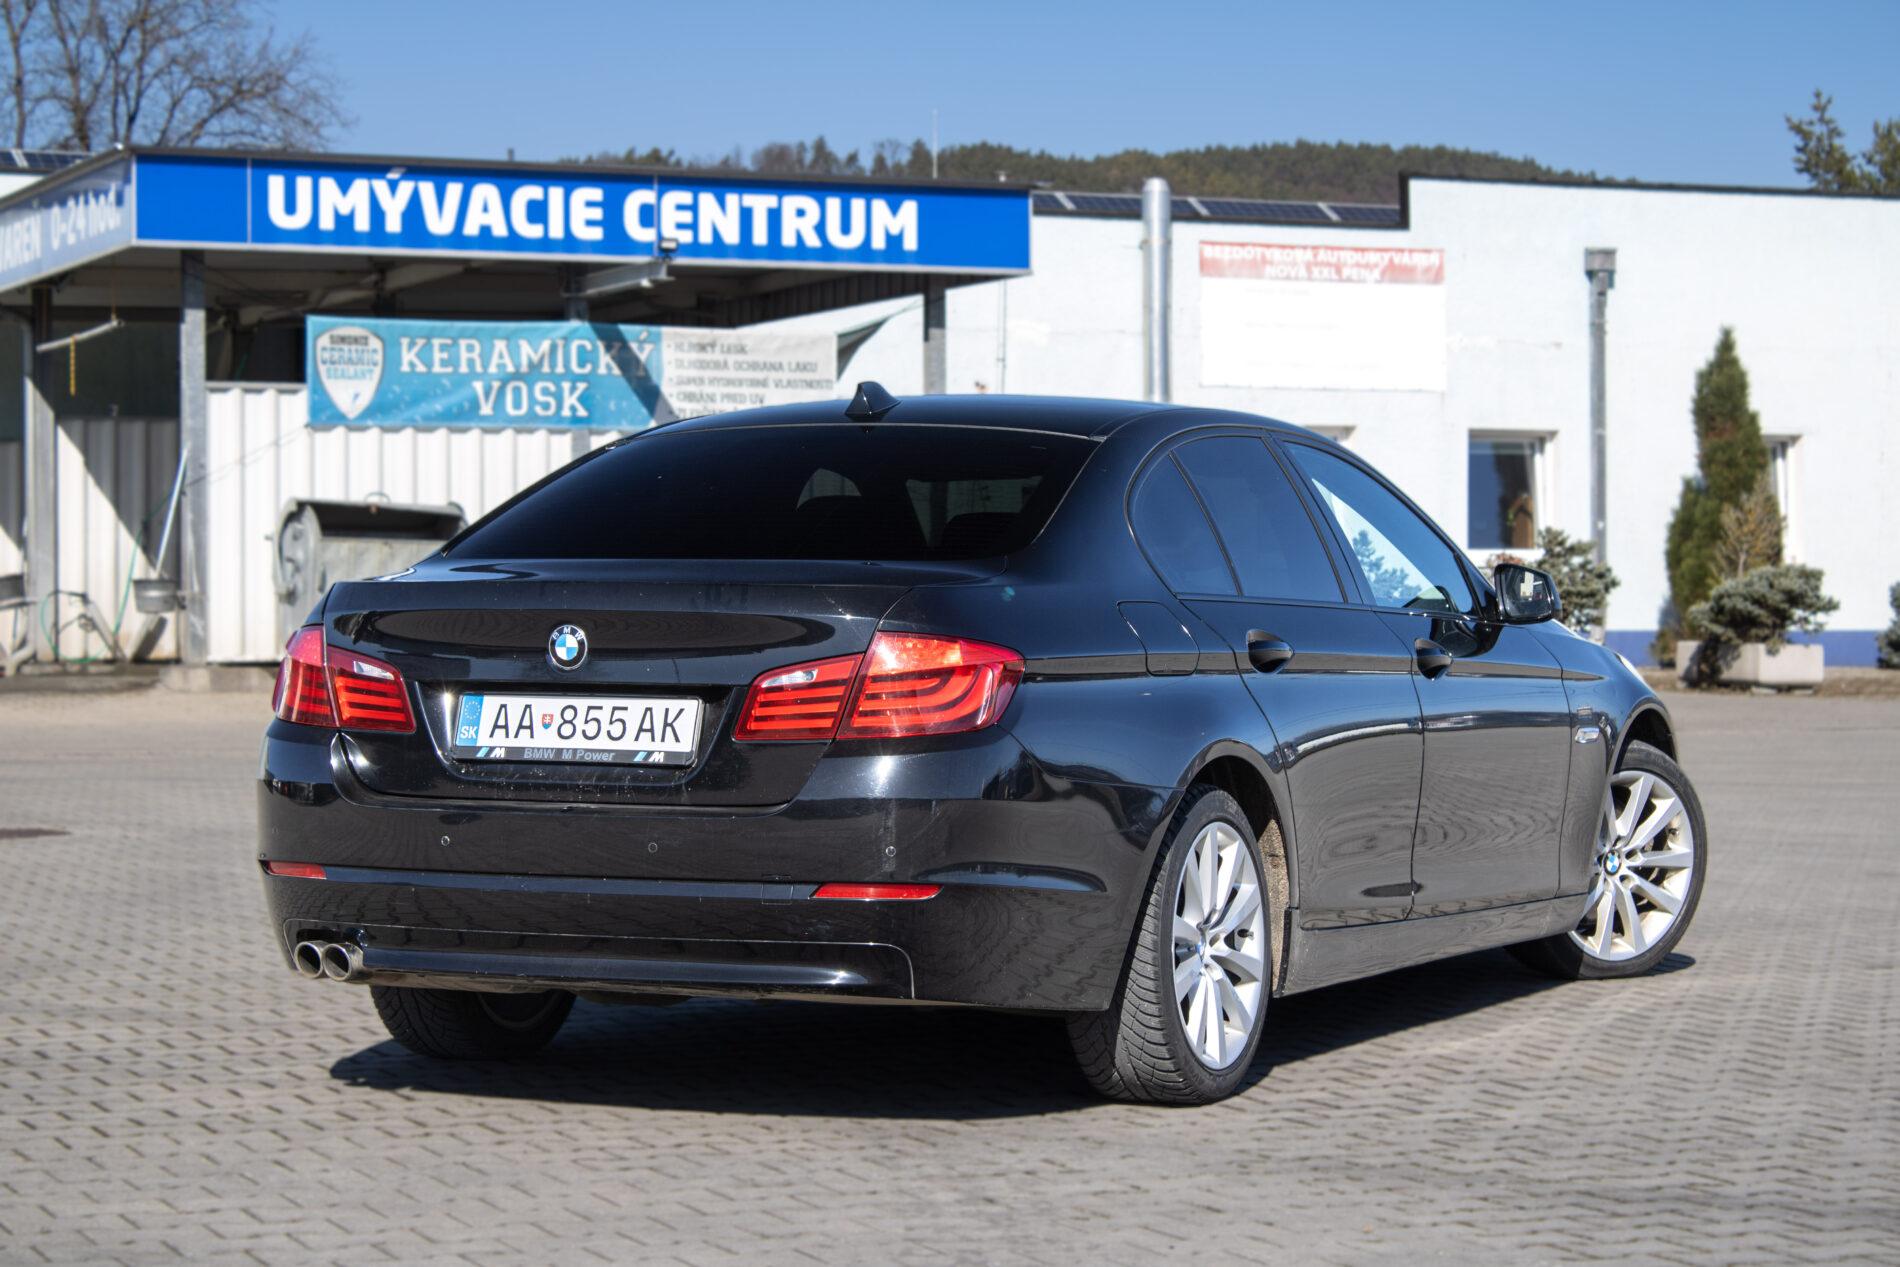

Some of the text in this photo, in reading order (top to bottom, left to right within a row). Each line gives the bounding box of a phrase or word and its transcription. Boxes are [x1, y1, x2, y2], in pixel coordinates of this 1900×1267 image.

[267, 167, 918, 251] UMÝVACIE CENTRUM
[320, 346, 379, 367] CERAMIC
[400, 330, 656, 376] KERAMICKÝ
[326, 367, 374, 380] SEALANT
[733, 360, 784, 373] OCHRANA
[787, 361, 817, 373] LAKU
[472, 380, 588, 417] VOSK
[552, 626, 584, 640] BMW
[489, 703, 535, 739] AA
[460, 726, 477, 739] SK
[523, 748, 615, 762] BMW M Power
